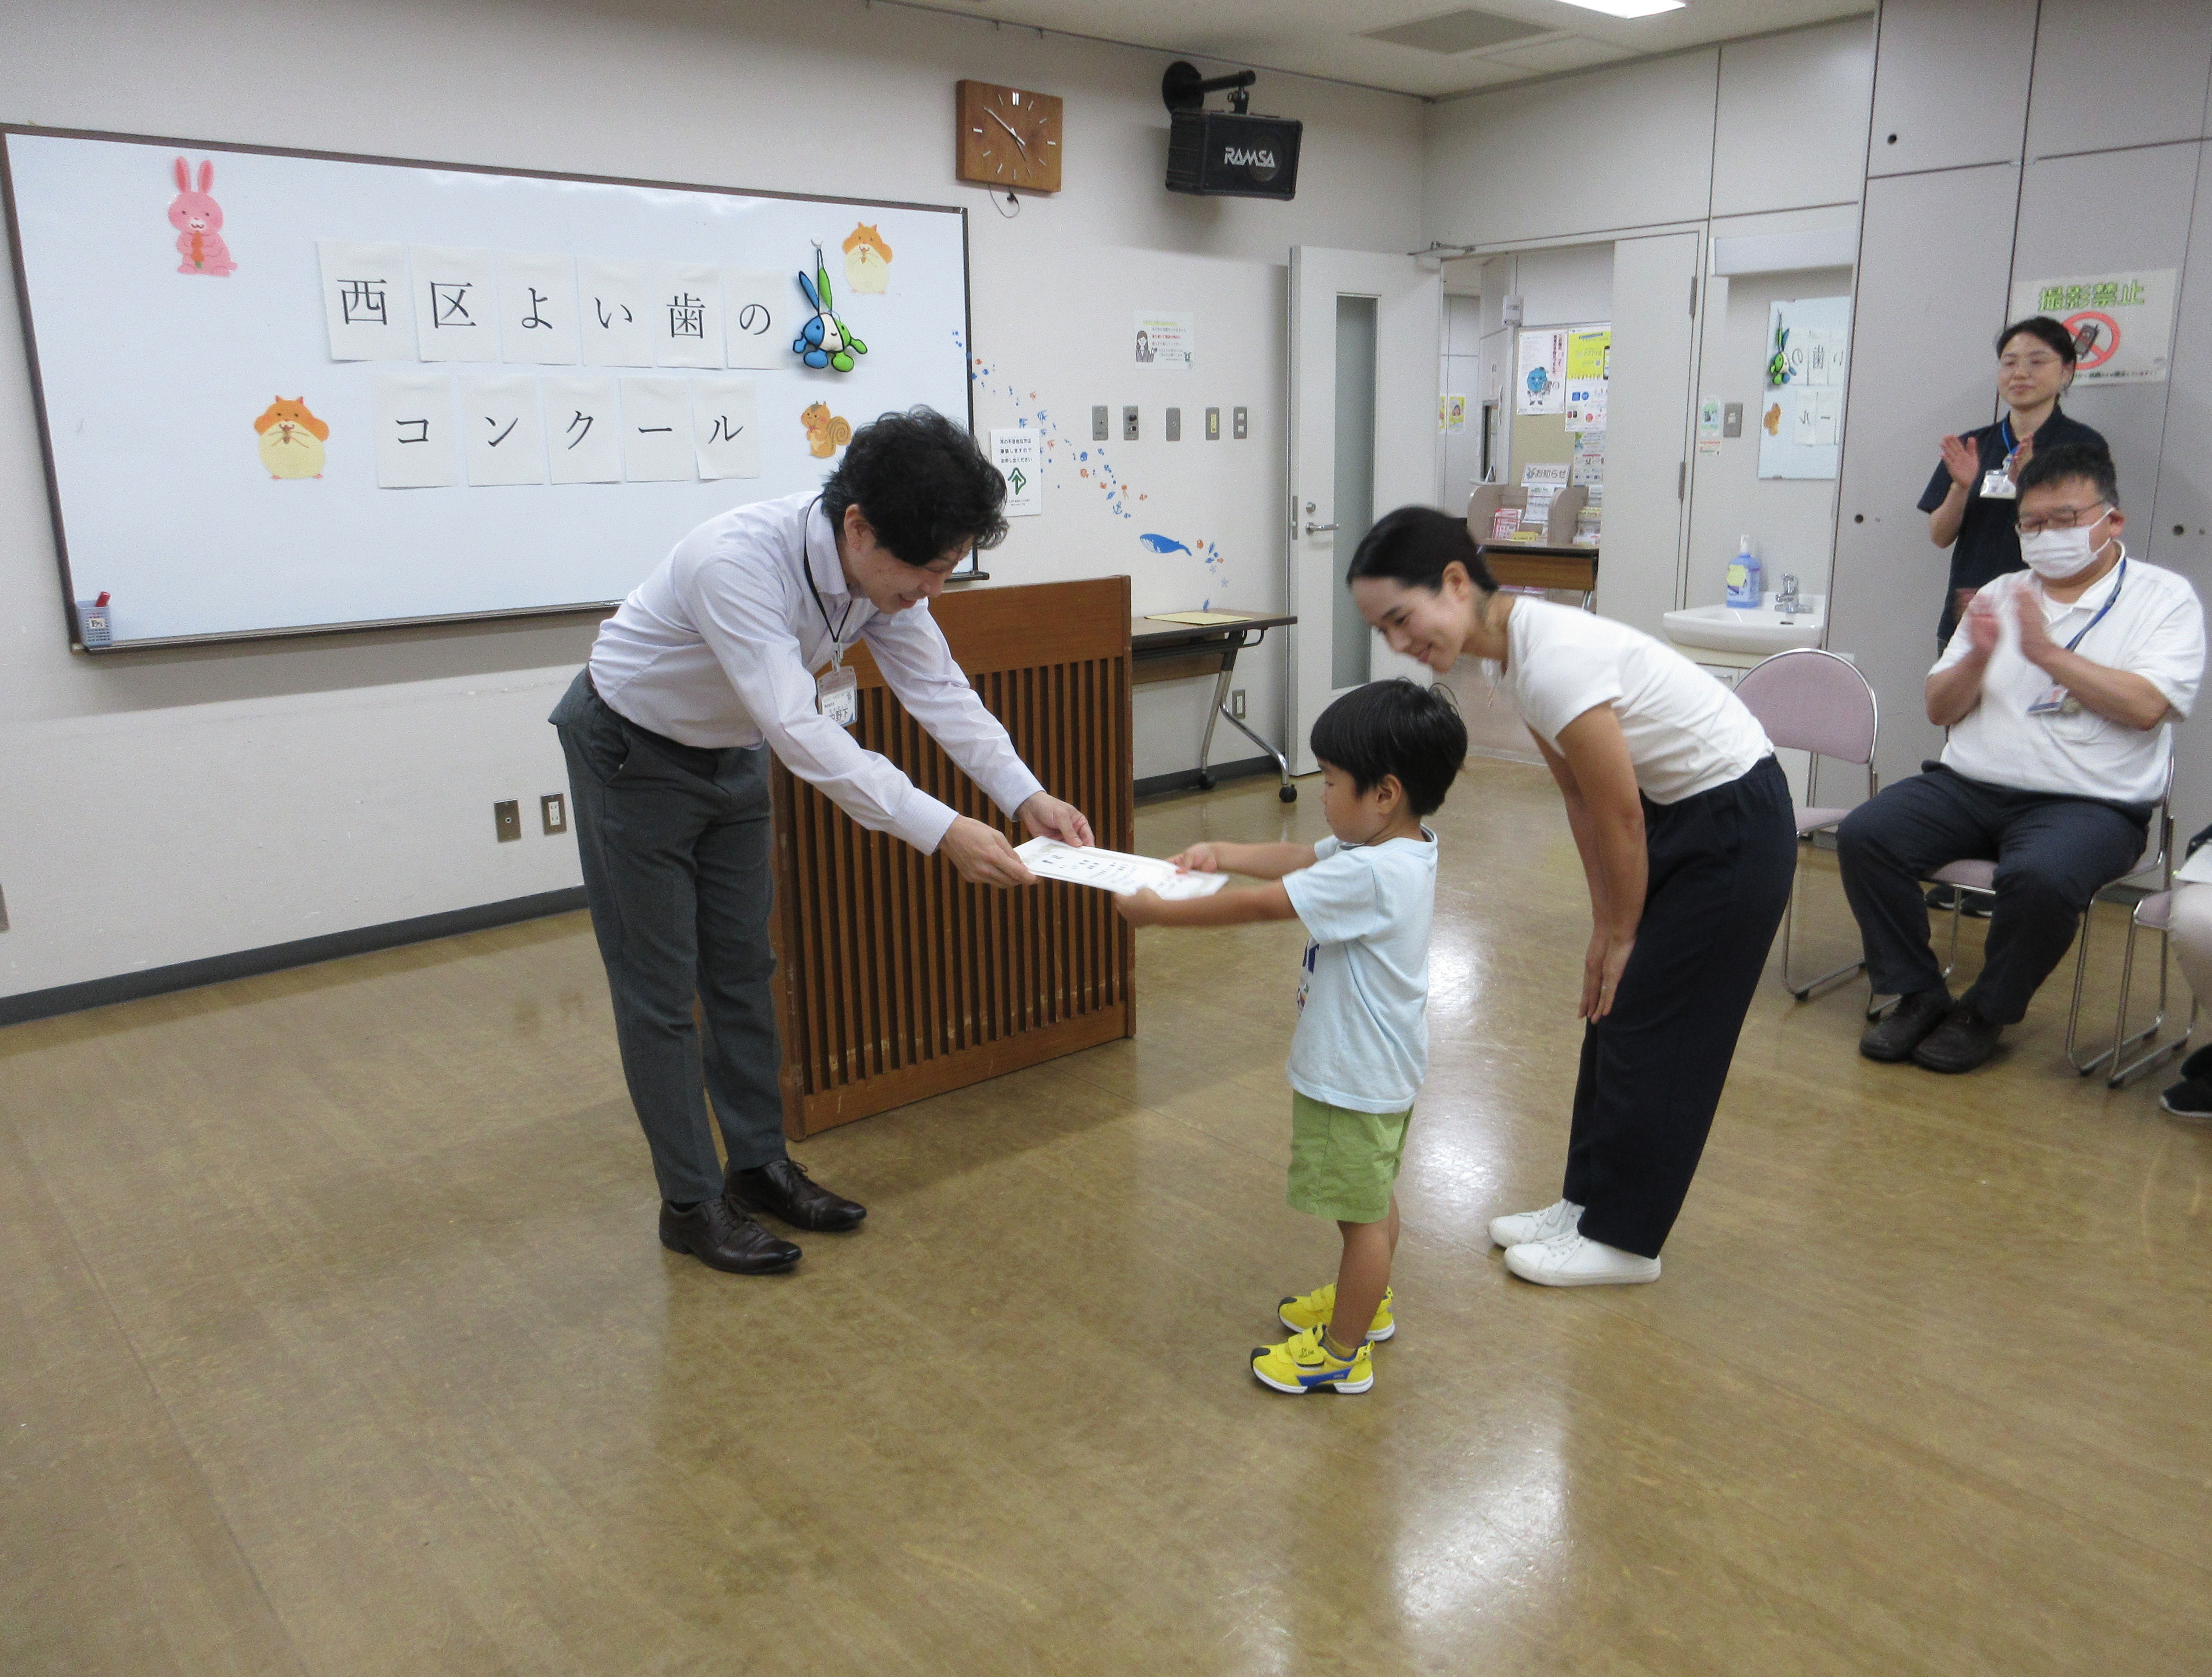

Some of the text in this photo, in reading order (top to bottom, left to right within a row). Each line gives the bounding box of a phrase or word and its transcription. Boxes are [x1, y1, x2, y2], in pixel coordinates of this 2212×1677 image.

[1224, 147, 1275, 168] RAMSA
[337, 279, 771, 339] 西区よい歯の
[2038, 279, 2144, 311] 撮影禁止
[395, 410, 744, 450] コンクール
